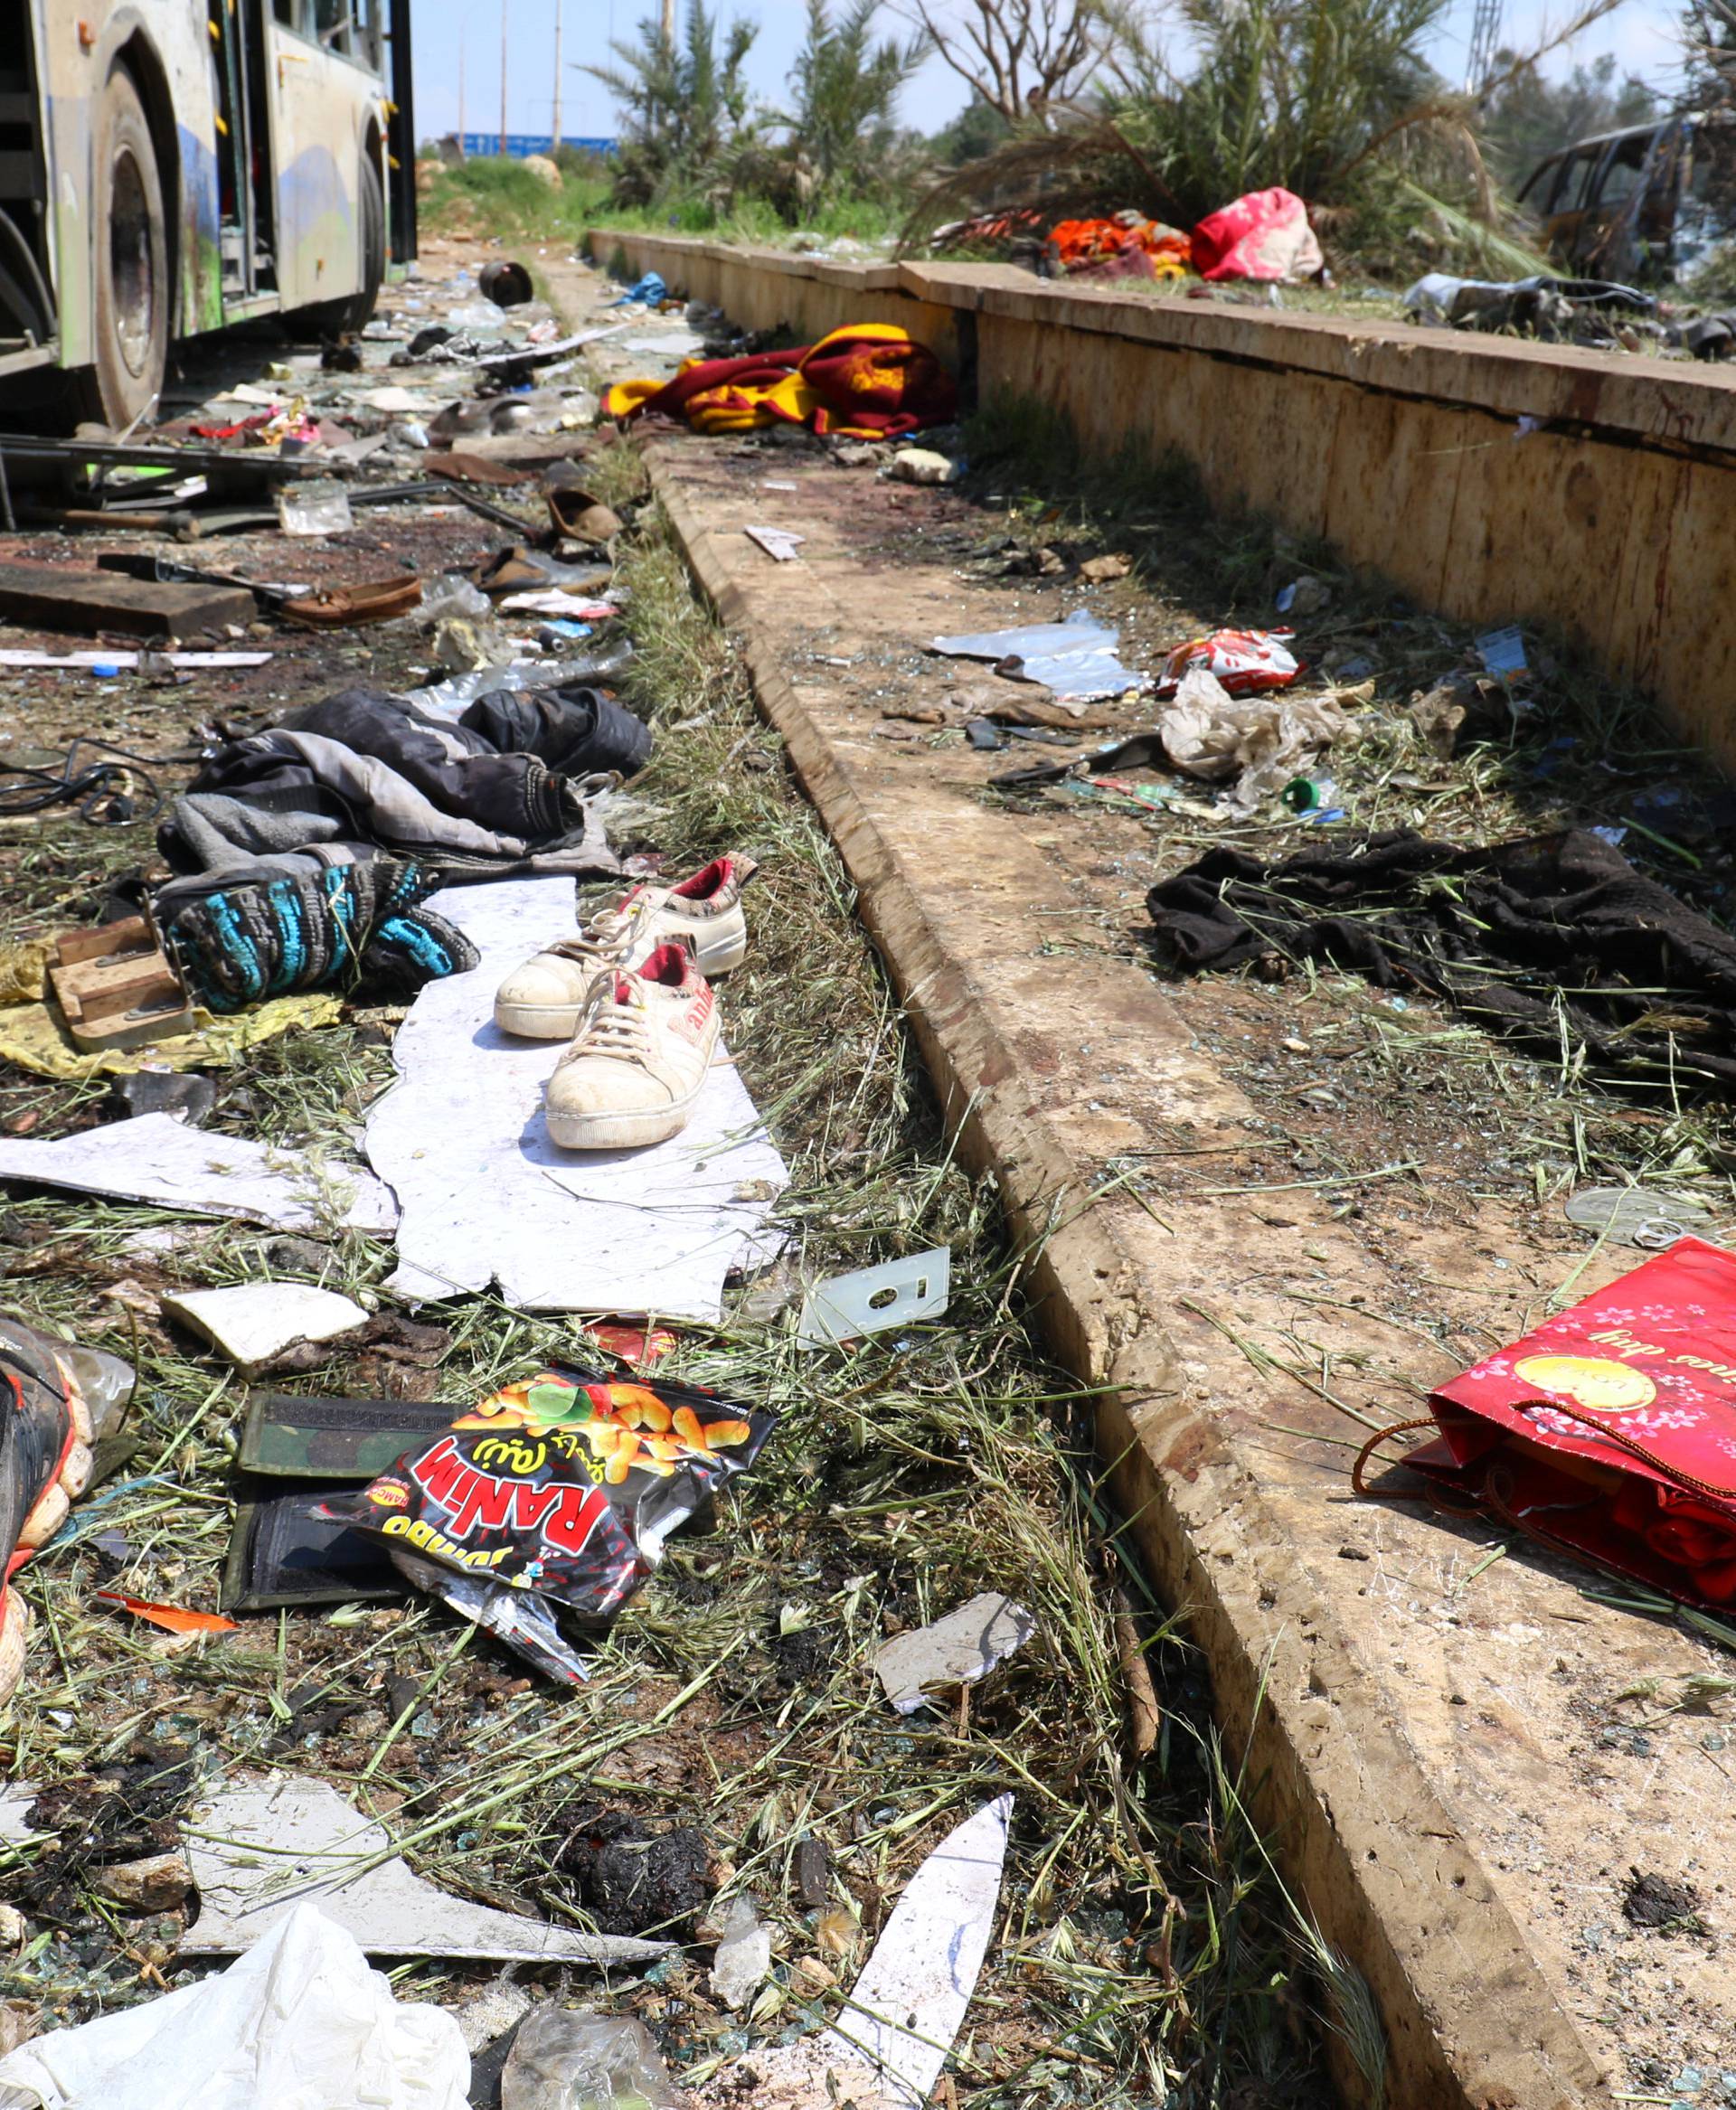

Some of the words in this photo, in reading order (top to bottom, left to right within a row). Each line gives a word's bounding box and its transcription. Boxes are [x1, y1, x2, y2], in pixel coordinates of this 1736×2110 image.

[1587, 1329, 1665, 1359] day
[473, 1438, 546, 1474] رنيم
[382, 1515, 514, 1567] JUMBO
